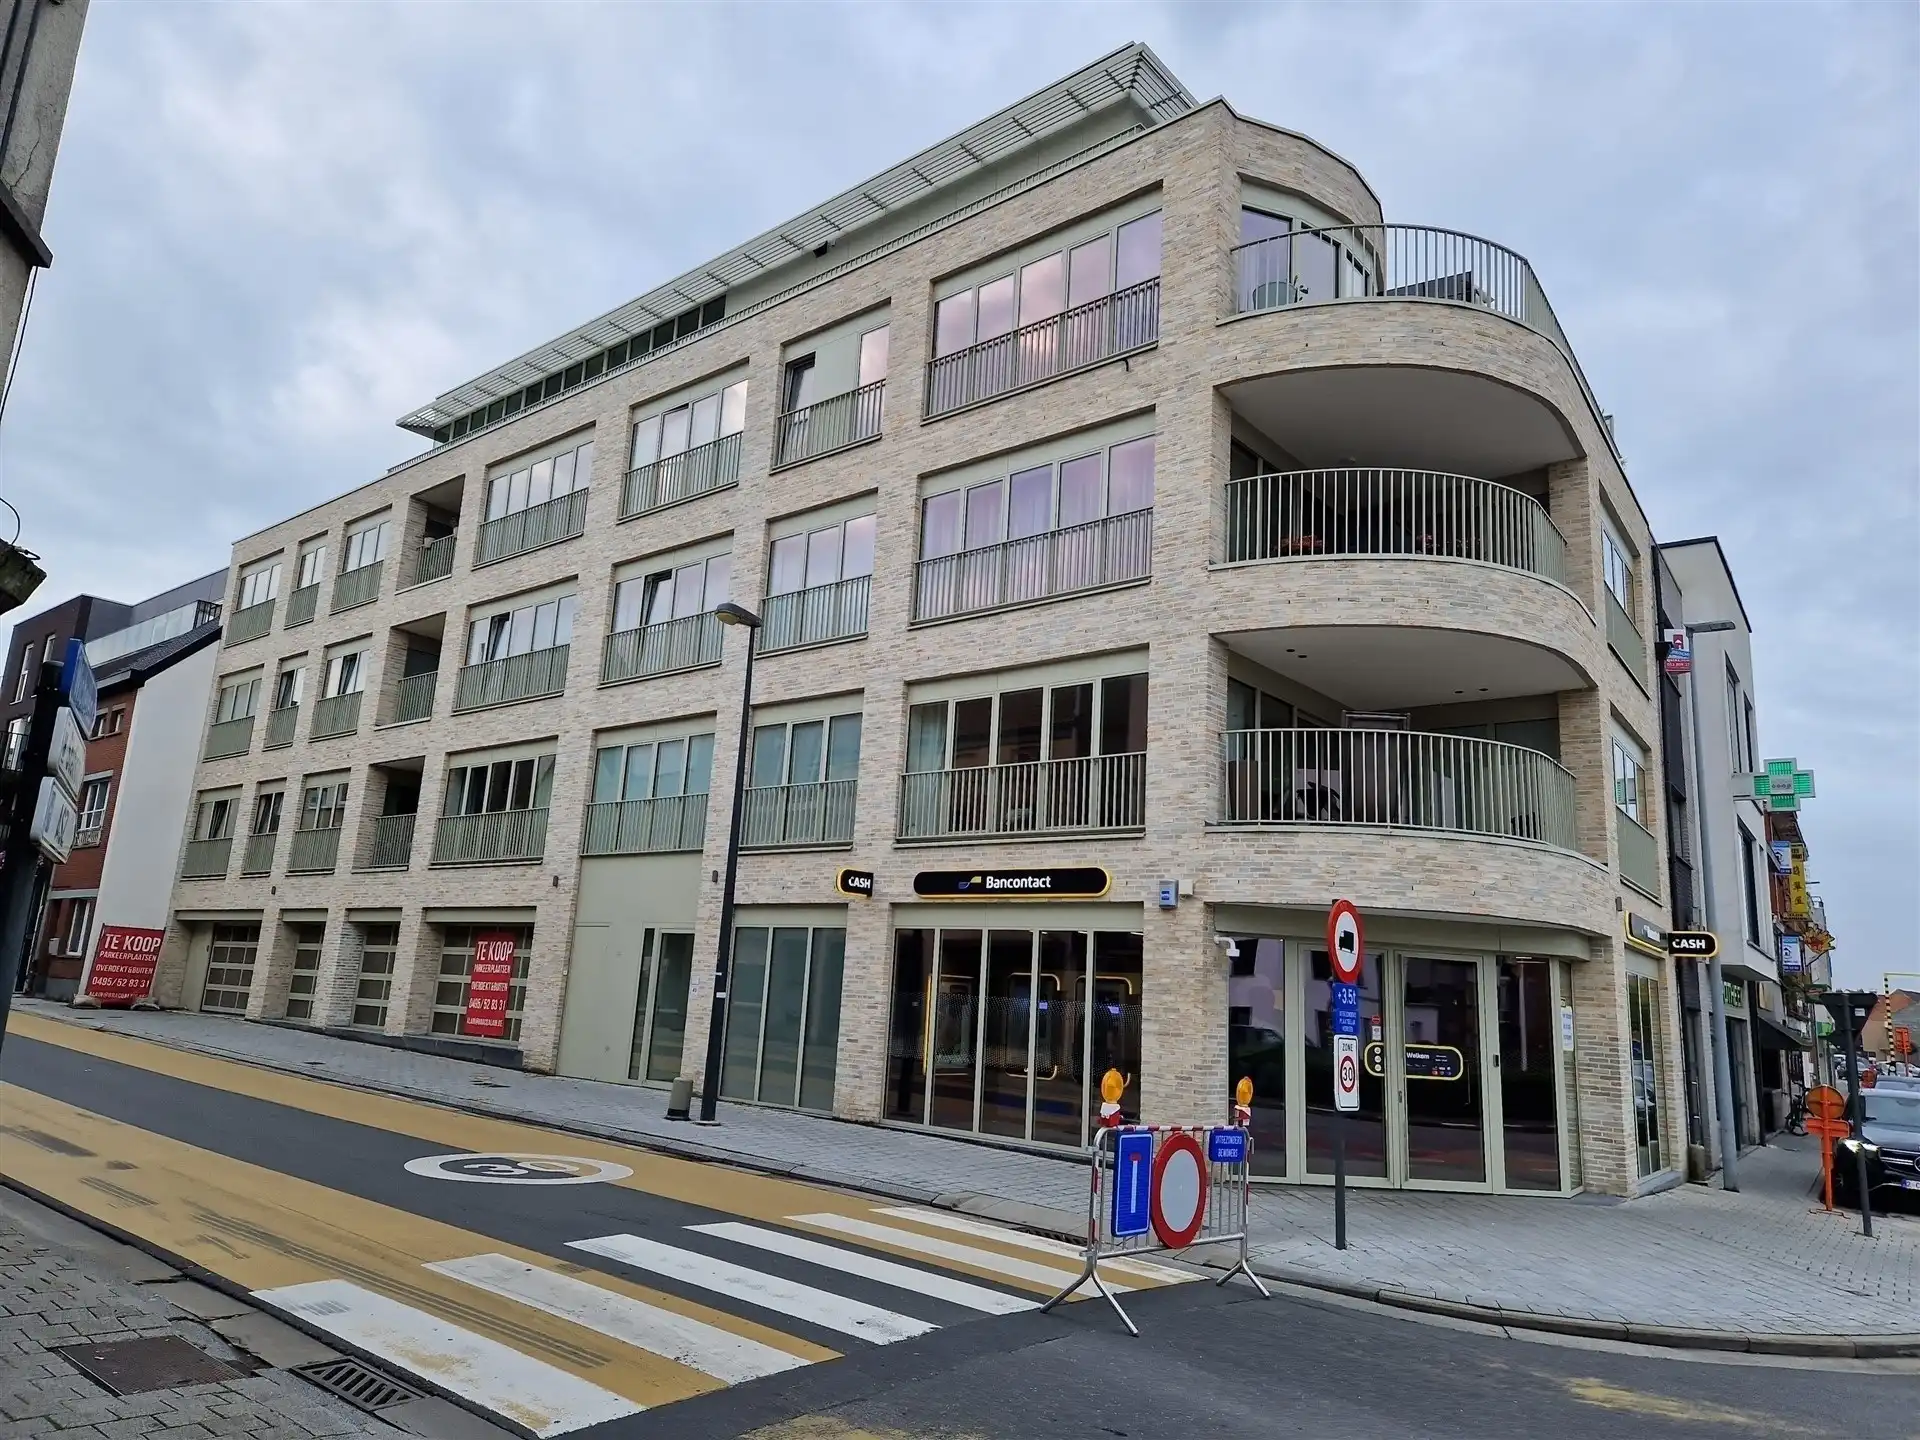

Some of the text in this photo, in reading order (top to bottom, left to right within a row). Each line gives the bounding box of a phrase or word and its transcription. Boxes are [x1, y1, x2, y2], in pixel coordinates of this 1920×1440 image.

[848, 876, 871, 889] CASH
[985, 875, 1051, 889] Bancontact
[104, 933, 161, 953] TE KOOP
[1672, 939, 1706, 949] CASH
[99, 950, 158, 962] PARKEERPLAATSEN
[476, 941, 514, 961] TE KOOP
[92, 976, 128, 988] 0495/52
[140, 980, 150, 988] 31
[1342, 1043, 1353, 1051] ZONE
[1406, 1052, 1430, 1060] Welkom
[1342, 1067, 1353, 1081] 30
[463, 1161, 580, 1176] 30
